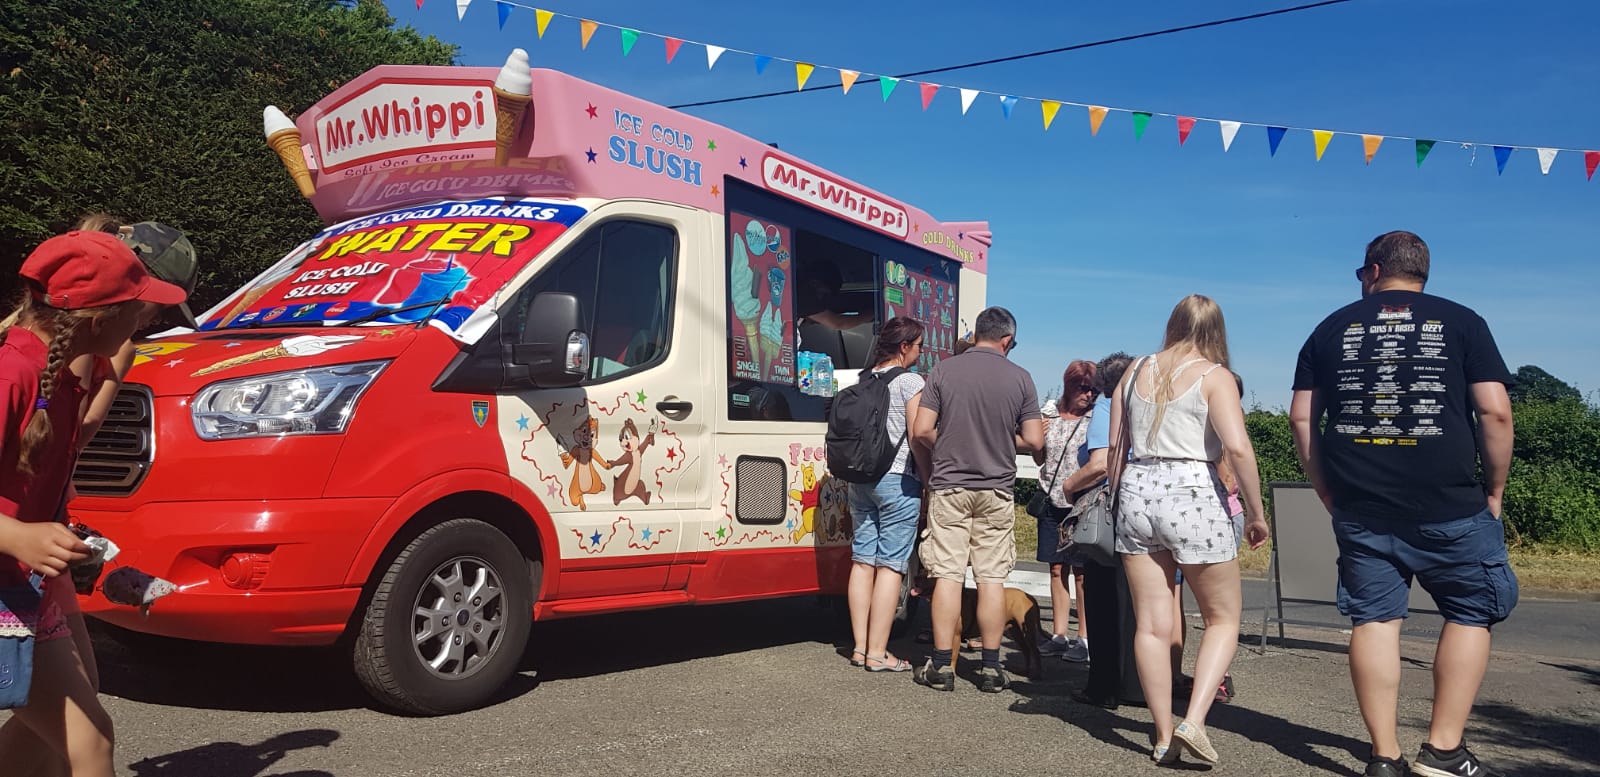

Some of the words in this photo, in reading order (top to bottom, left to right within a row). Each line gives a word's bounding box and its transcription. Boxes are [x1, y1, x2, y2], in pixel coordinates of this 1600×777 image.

[614, 109, 643, 136] ICE
[651, 123, 694, 152] COLD
[416, 154, 475, 164] Cream
[609, 135, 702, 187] SLUSH
[337, 216, 380, 235] ICE
[378, 207, 443, 225] COLD
[442, 204, 560, 220] DRINKS
[319, 223, 531, 261] WATER
[923, 232, 944, 245] COLD
[946, 236, 975, 263] DRINKS
[291, 268, 333, 284] ICE
[330, 261, 390, 278] COLD
[283, 281, 359, 299] SLUSH
[1422, 323, 1444, 333] OZZY
[736, 360, 760, 373] SINGLE
[1459, 760, 1479, 776] N
